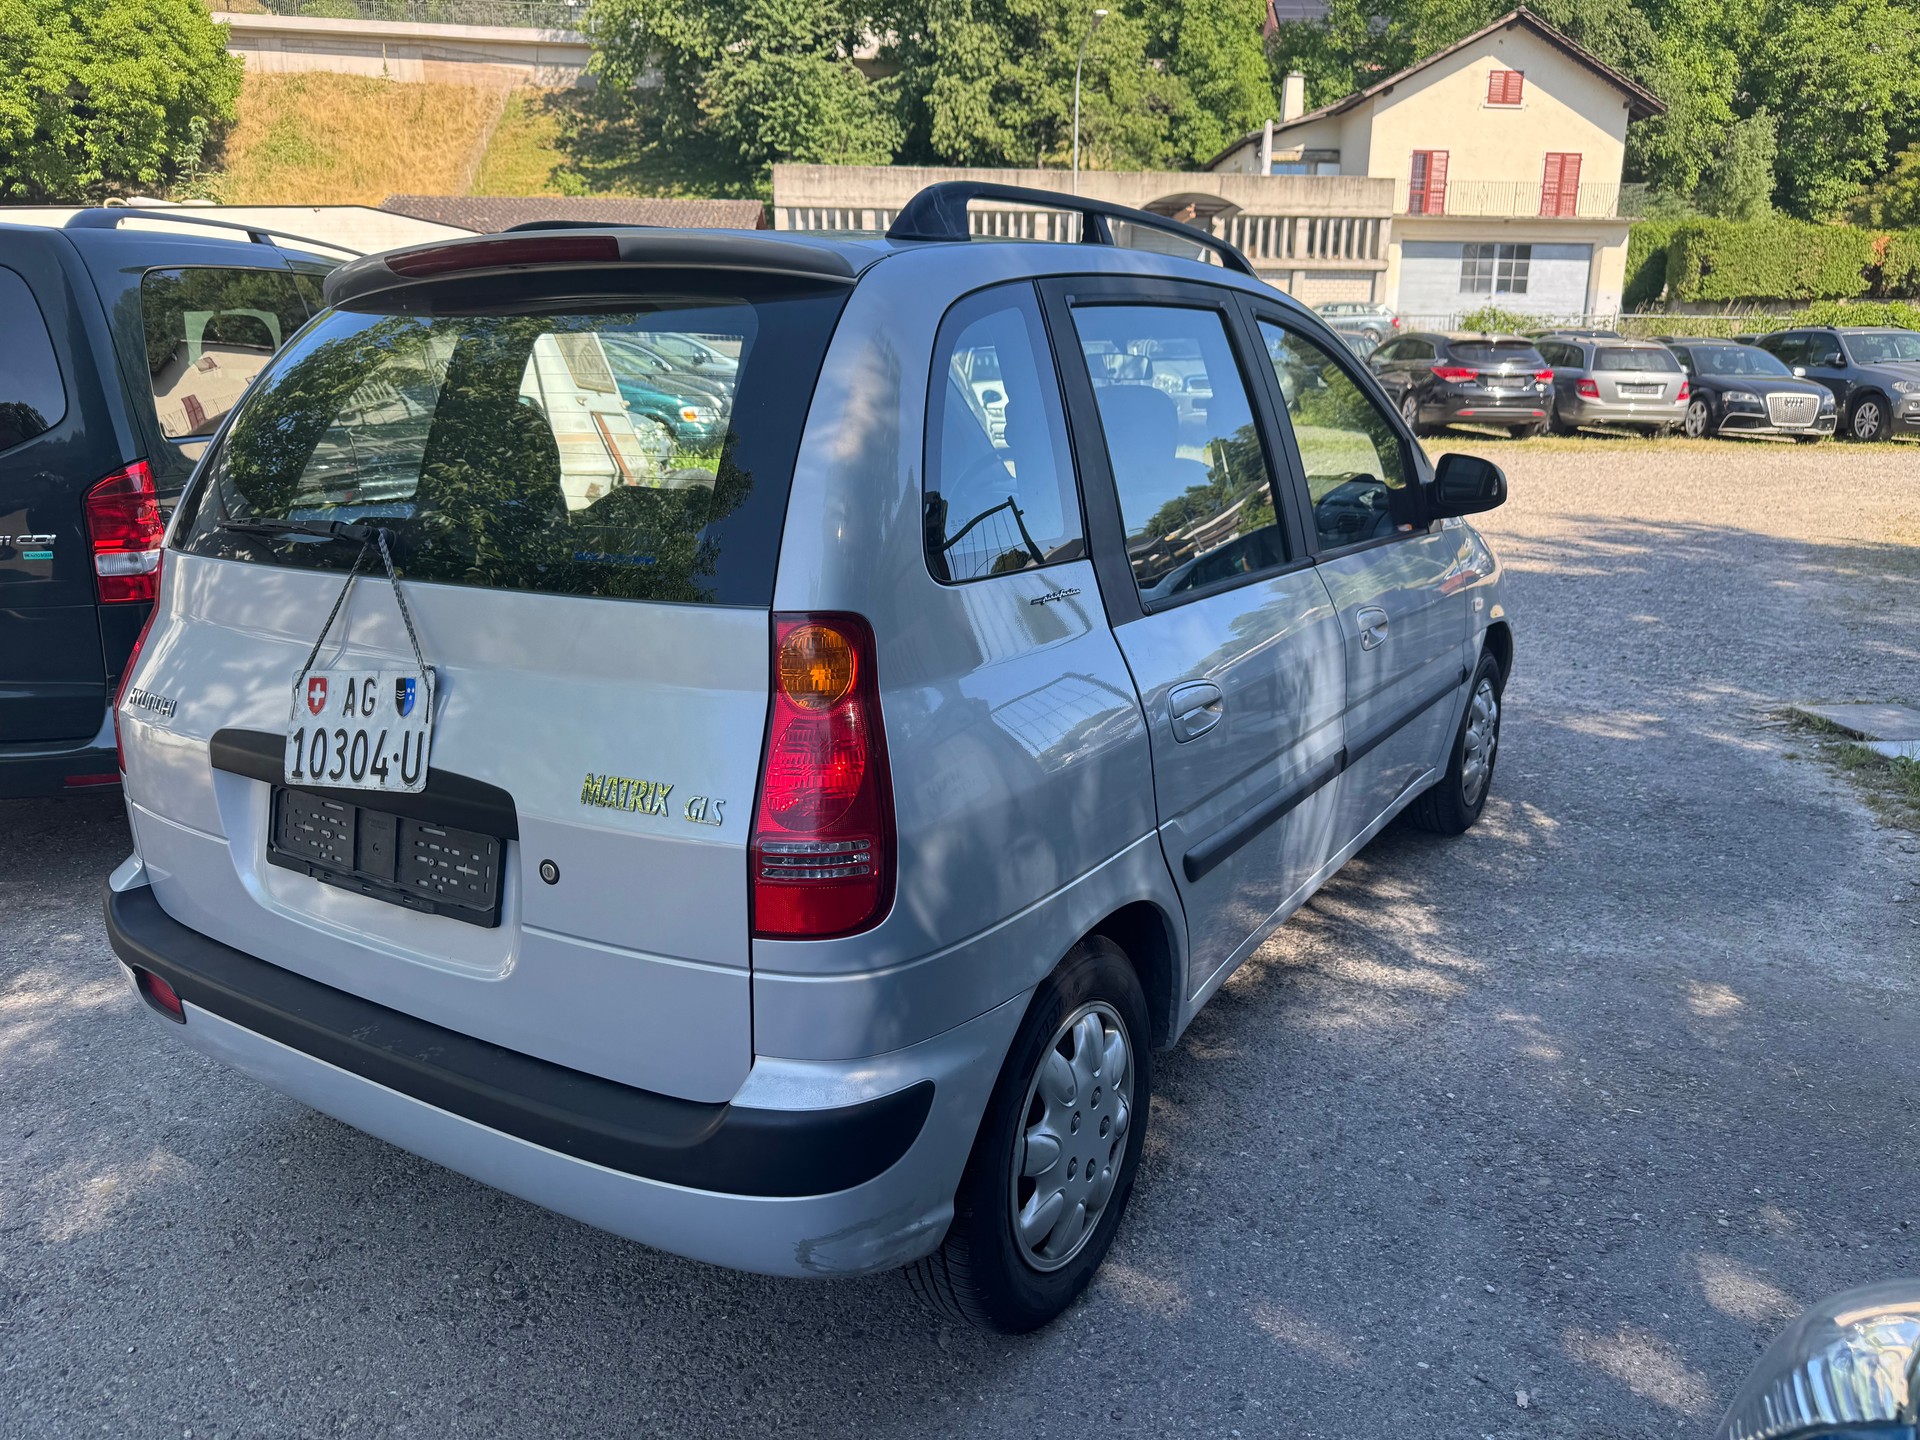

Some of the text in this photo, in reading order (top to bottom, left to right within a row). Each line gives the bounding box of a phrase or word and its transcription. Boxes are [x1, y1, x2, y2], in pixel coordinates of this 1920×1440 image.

[16, 534, 57, 545] CDI
[129, 688, 177, 718] HYUNDAI
[342, 677, 378, 717] AG
[580, 773, 726, 826] MATRIX GLS
